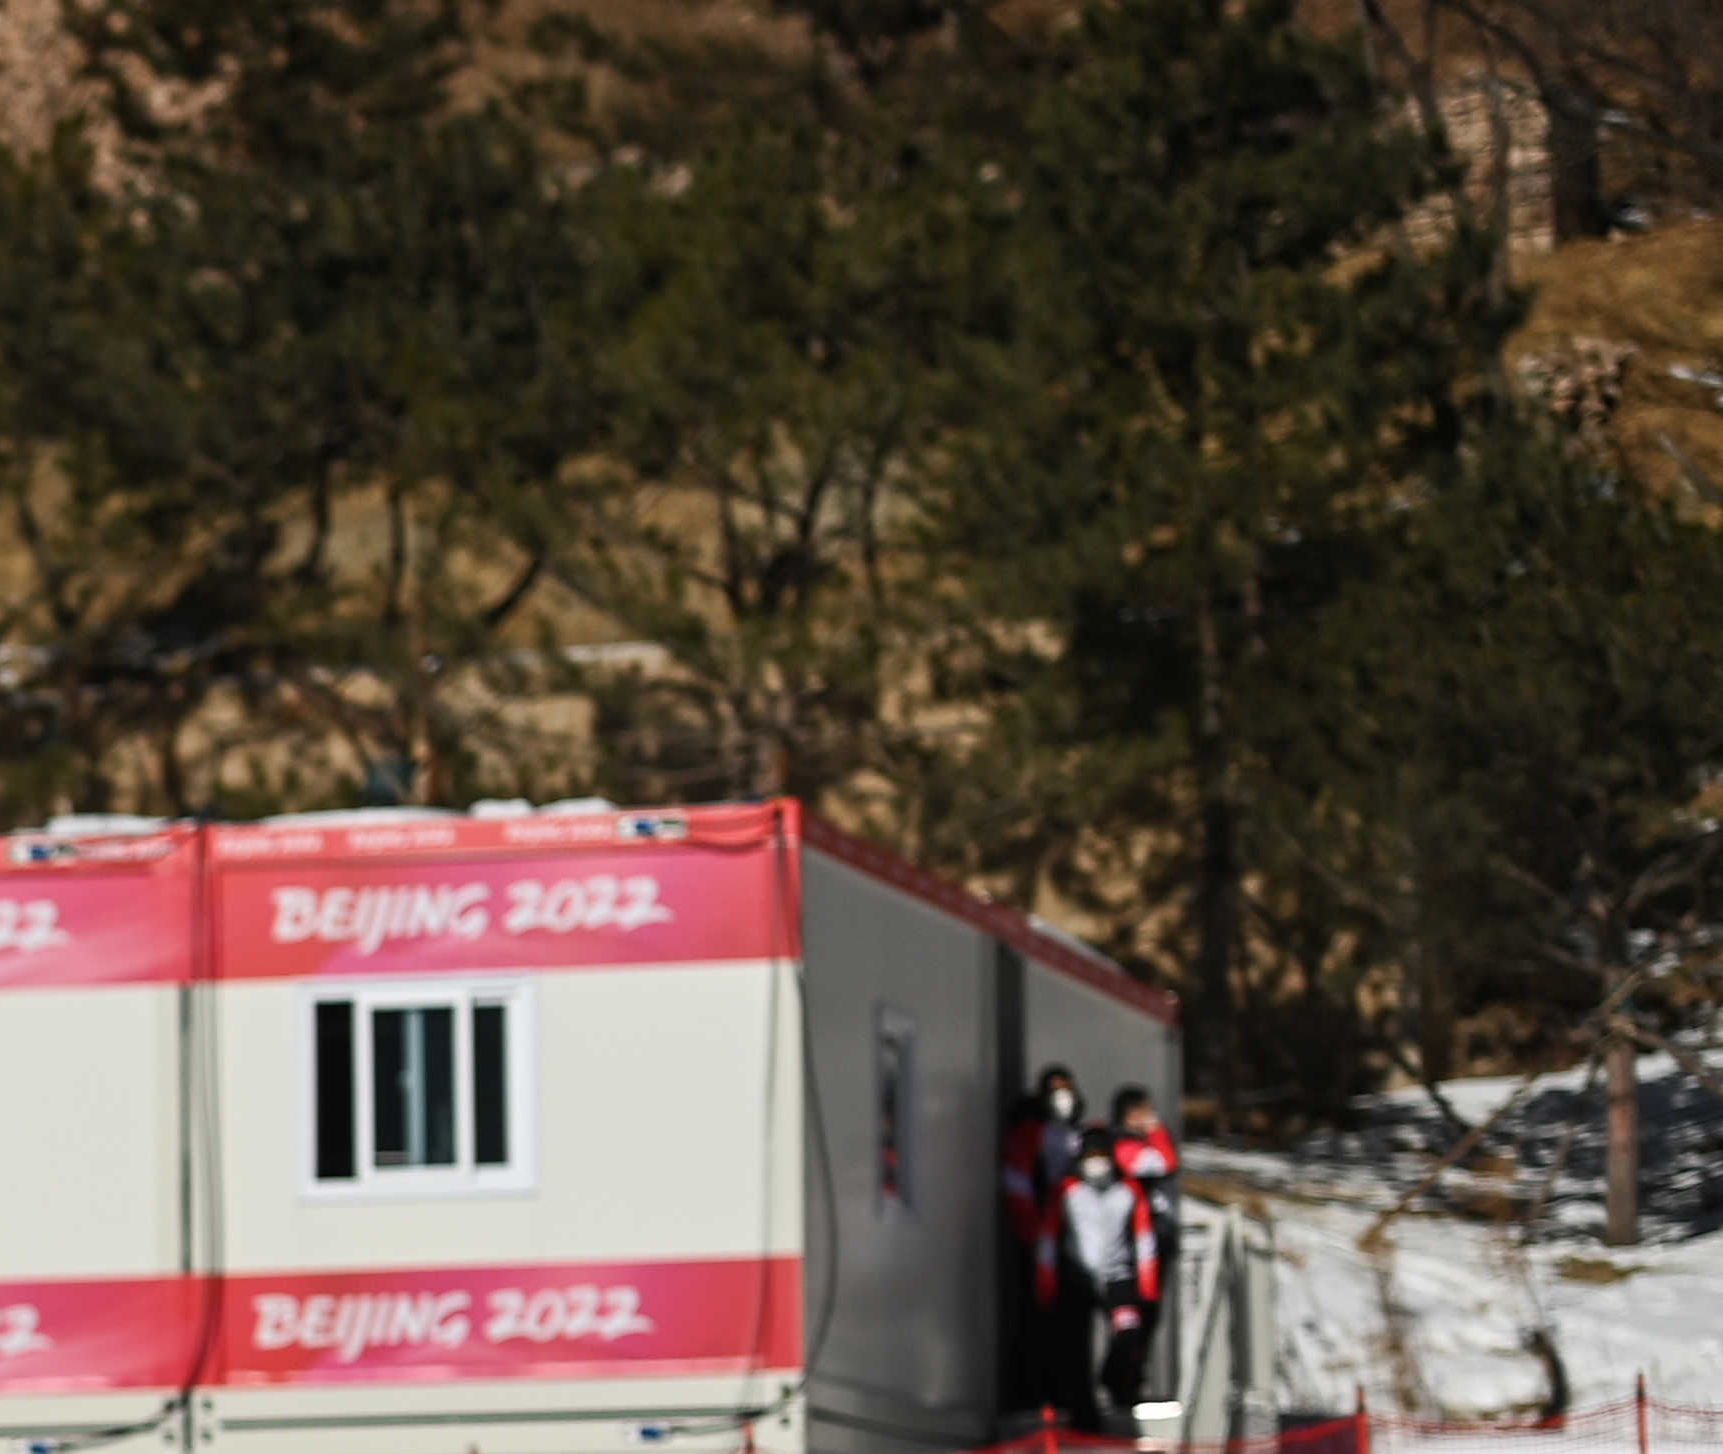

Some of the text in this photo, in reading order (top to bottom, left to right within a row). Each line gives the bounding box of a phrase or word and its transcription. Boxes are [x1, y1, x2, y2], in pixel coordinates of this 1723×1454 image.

[273, 874, 669, 955] BEIJING 2022
[255, 1284, 649, 1362] BEIJING 2022
